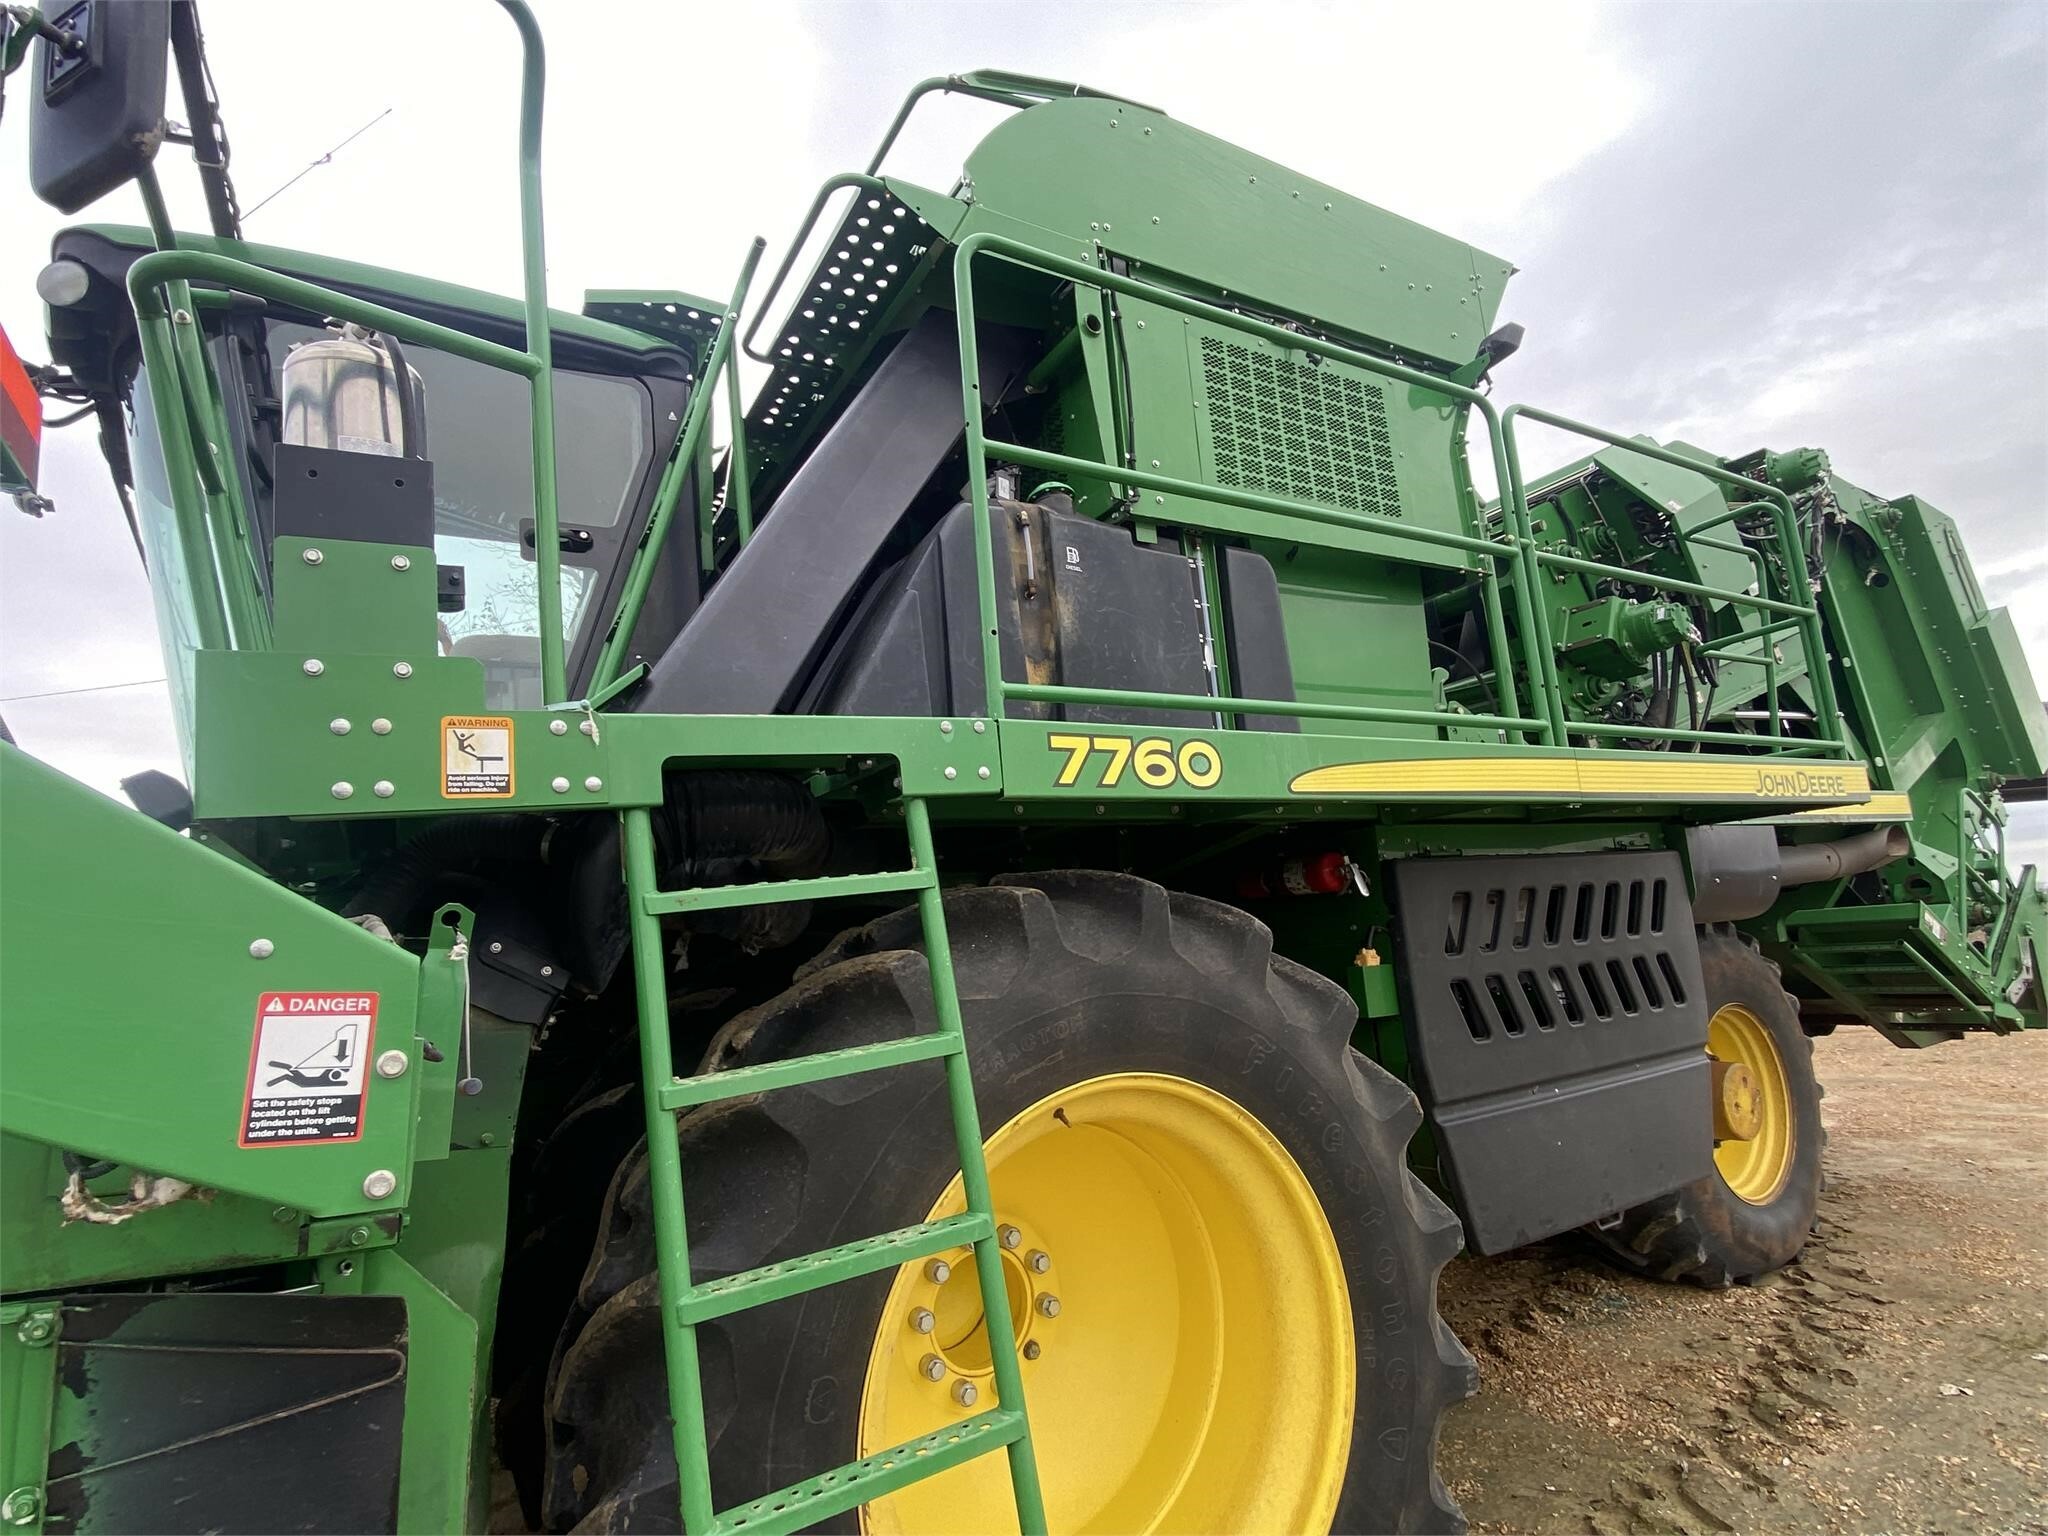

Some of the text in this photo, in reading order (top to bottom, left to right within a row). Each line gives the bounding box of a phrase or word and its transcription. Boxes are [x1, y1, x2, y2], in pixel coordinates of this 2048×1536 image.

[457, 719, 509, 727] WARNING
[1047, 732, 1223, 790] 7760
[1756, 770, 1846, 793] JOHN DEERE
[289, 998, 371, 1012] DANGER
[252, 1097, 342, 1109] Set the safety stops
[251, 1108, 286, 1118] located
[301, 1107, 317, 1116] the
[318, 1107, 331, 1115] lift
[249, 1115, 357, 1130] cylinders before getting
[248, 1127, 320, 1138] under the units.
